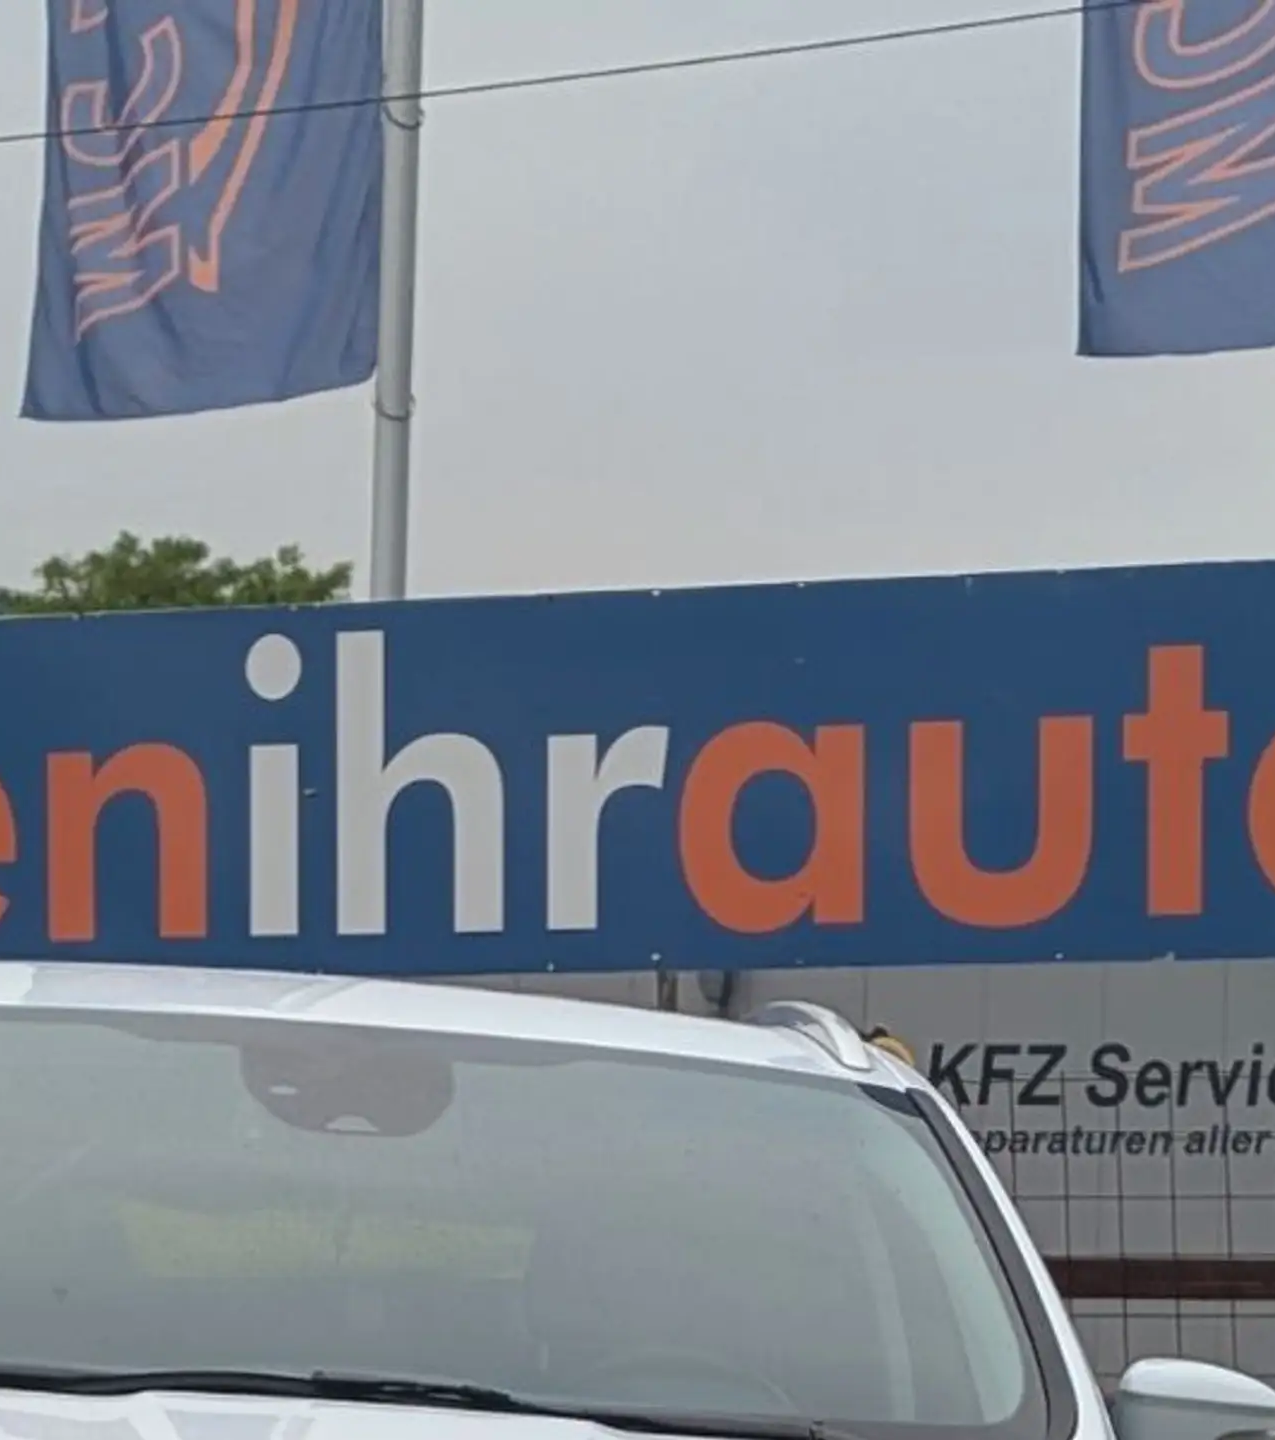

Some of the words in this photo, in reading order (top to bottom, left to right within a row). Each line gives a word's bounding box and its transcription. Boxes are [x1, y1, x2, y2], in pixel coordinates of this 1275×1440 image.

[929, 1042, 1066, 1106] KFZ
[972, 1125, 1172, 1157] paraturen
[1185, 1124, 1271, 1156] aller
